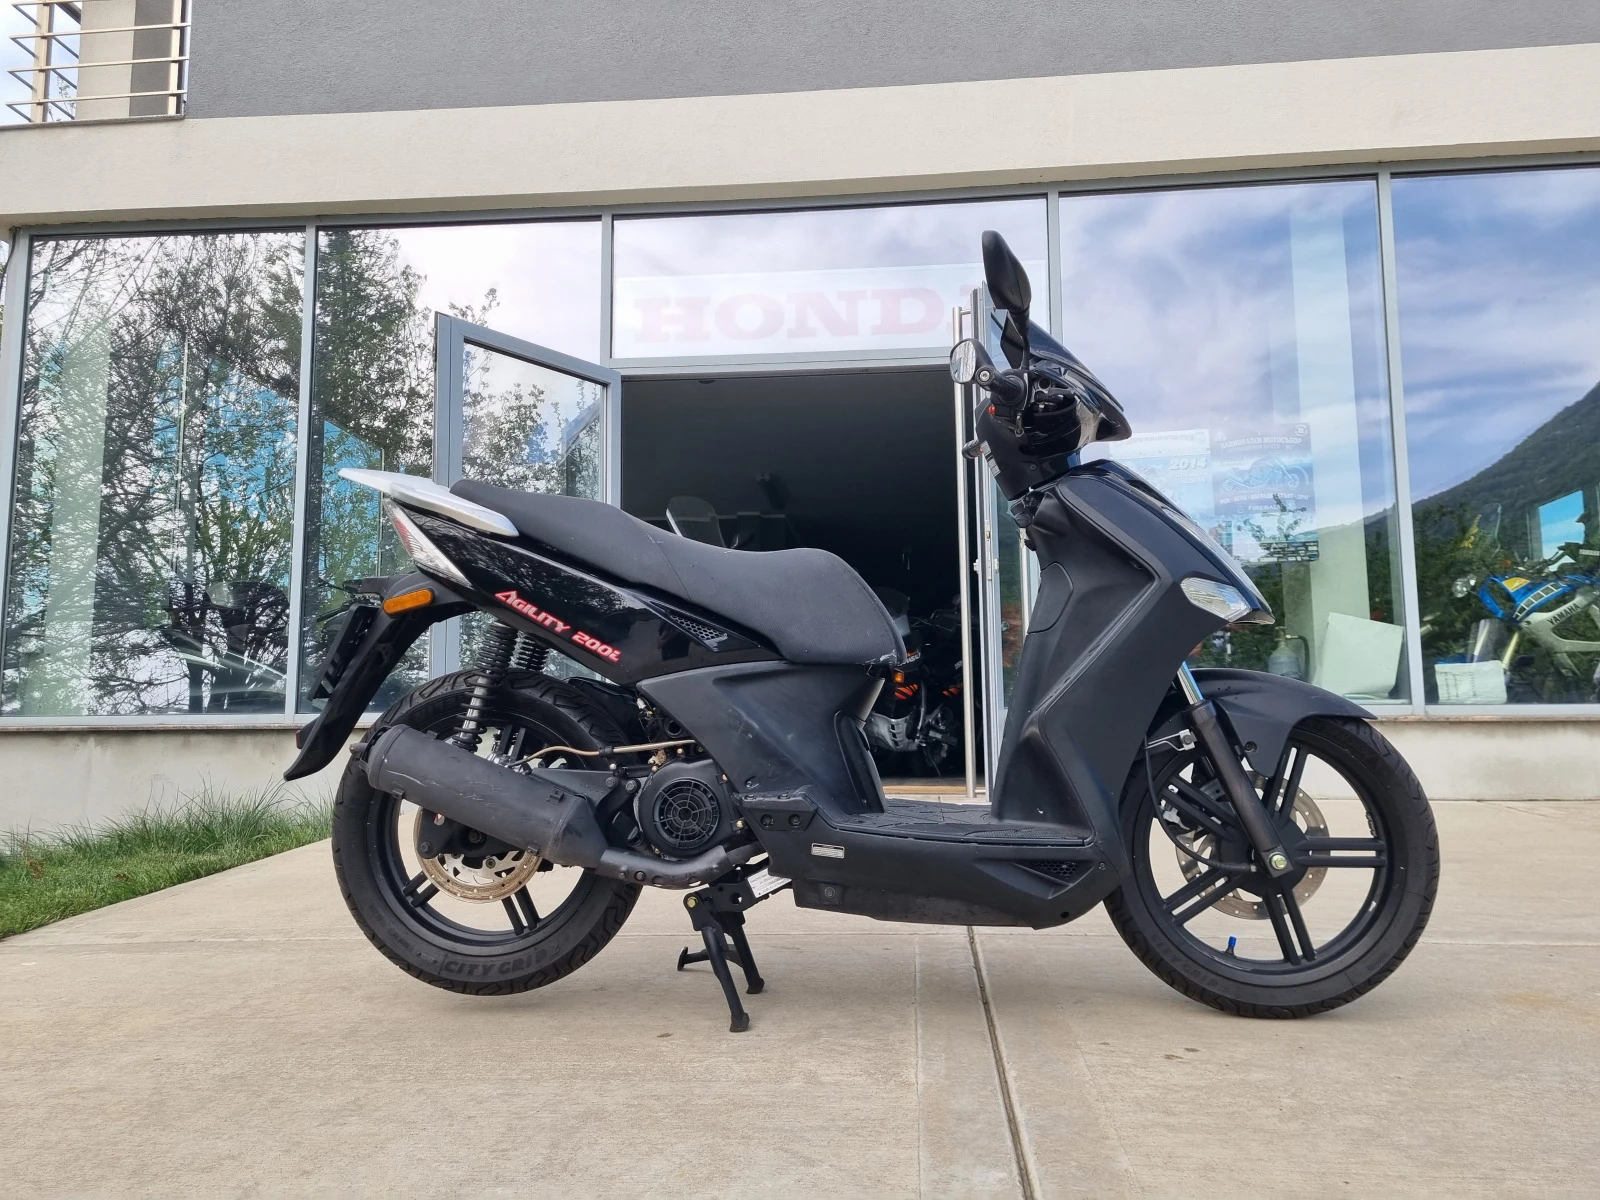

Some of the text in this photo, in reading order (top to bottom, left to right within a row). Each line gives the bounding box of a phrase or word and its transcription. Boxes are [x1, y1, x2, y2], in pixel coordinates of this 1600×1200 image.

[1169, 457, 1208, 471] 2014
[494, 590, 571, 633] AGILITY
[1547, 603, 1580, 626] YAMAHA
[444, 959, 496, 976] CITY
